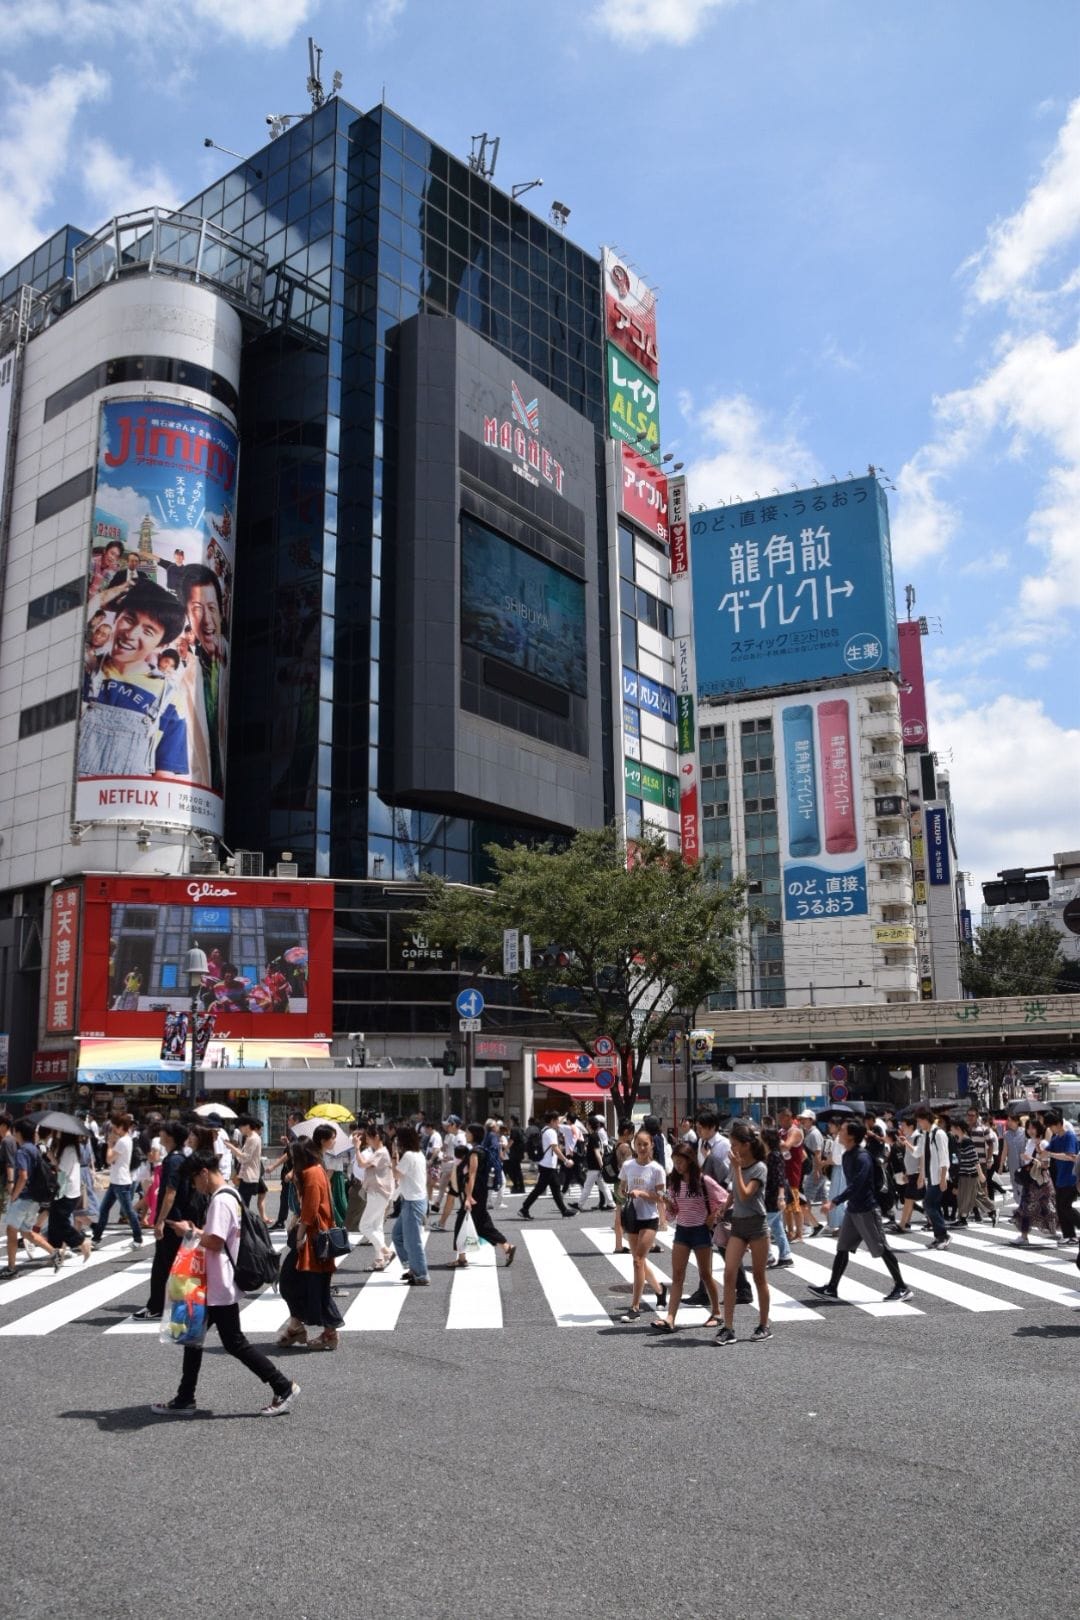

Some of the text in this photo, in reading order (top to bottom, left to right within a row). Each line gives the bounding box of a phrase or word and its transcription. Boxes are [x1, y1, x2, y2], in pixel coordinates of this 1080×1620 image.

[614, 303, 659, 365] アコム
[612, 356, 656, 413] レイク
[612, 392, 658, 444] ALSA
[104, 416, 234, 490] Jimmy
[484, 415, 564, 496] MAGNET
[623, 465, 667, 514] アイフル
[692, 486, 868, 536] のど、直接、うるおう
[674, 535, 685, 572] アイフル
[729, 525, 833, 585] 龍角散
[504, 595, 549, 633] SHIBUYA
[718, 575, 855, 633] ダイレクト
[731, 633, 788, 654] スティック
[846, 642, 879, 661] 生薬
[625, 767, 641, 782] レイク
[98, 788, 159, 807] NETFLIX
[684, 814, 696, 850] アコム
[187, 882, 237, 902] Glico
[788, 876, 865, 896] のど、直接、
[796, 896, 854, 916] うるおう
[53, 911, 72, 1027] 天津甘栗
[401, 949, 443, 959] COFFEE
[35, 1060, 67, 1074] 天津甘栗
